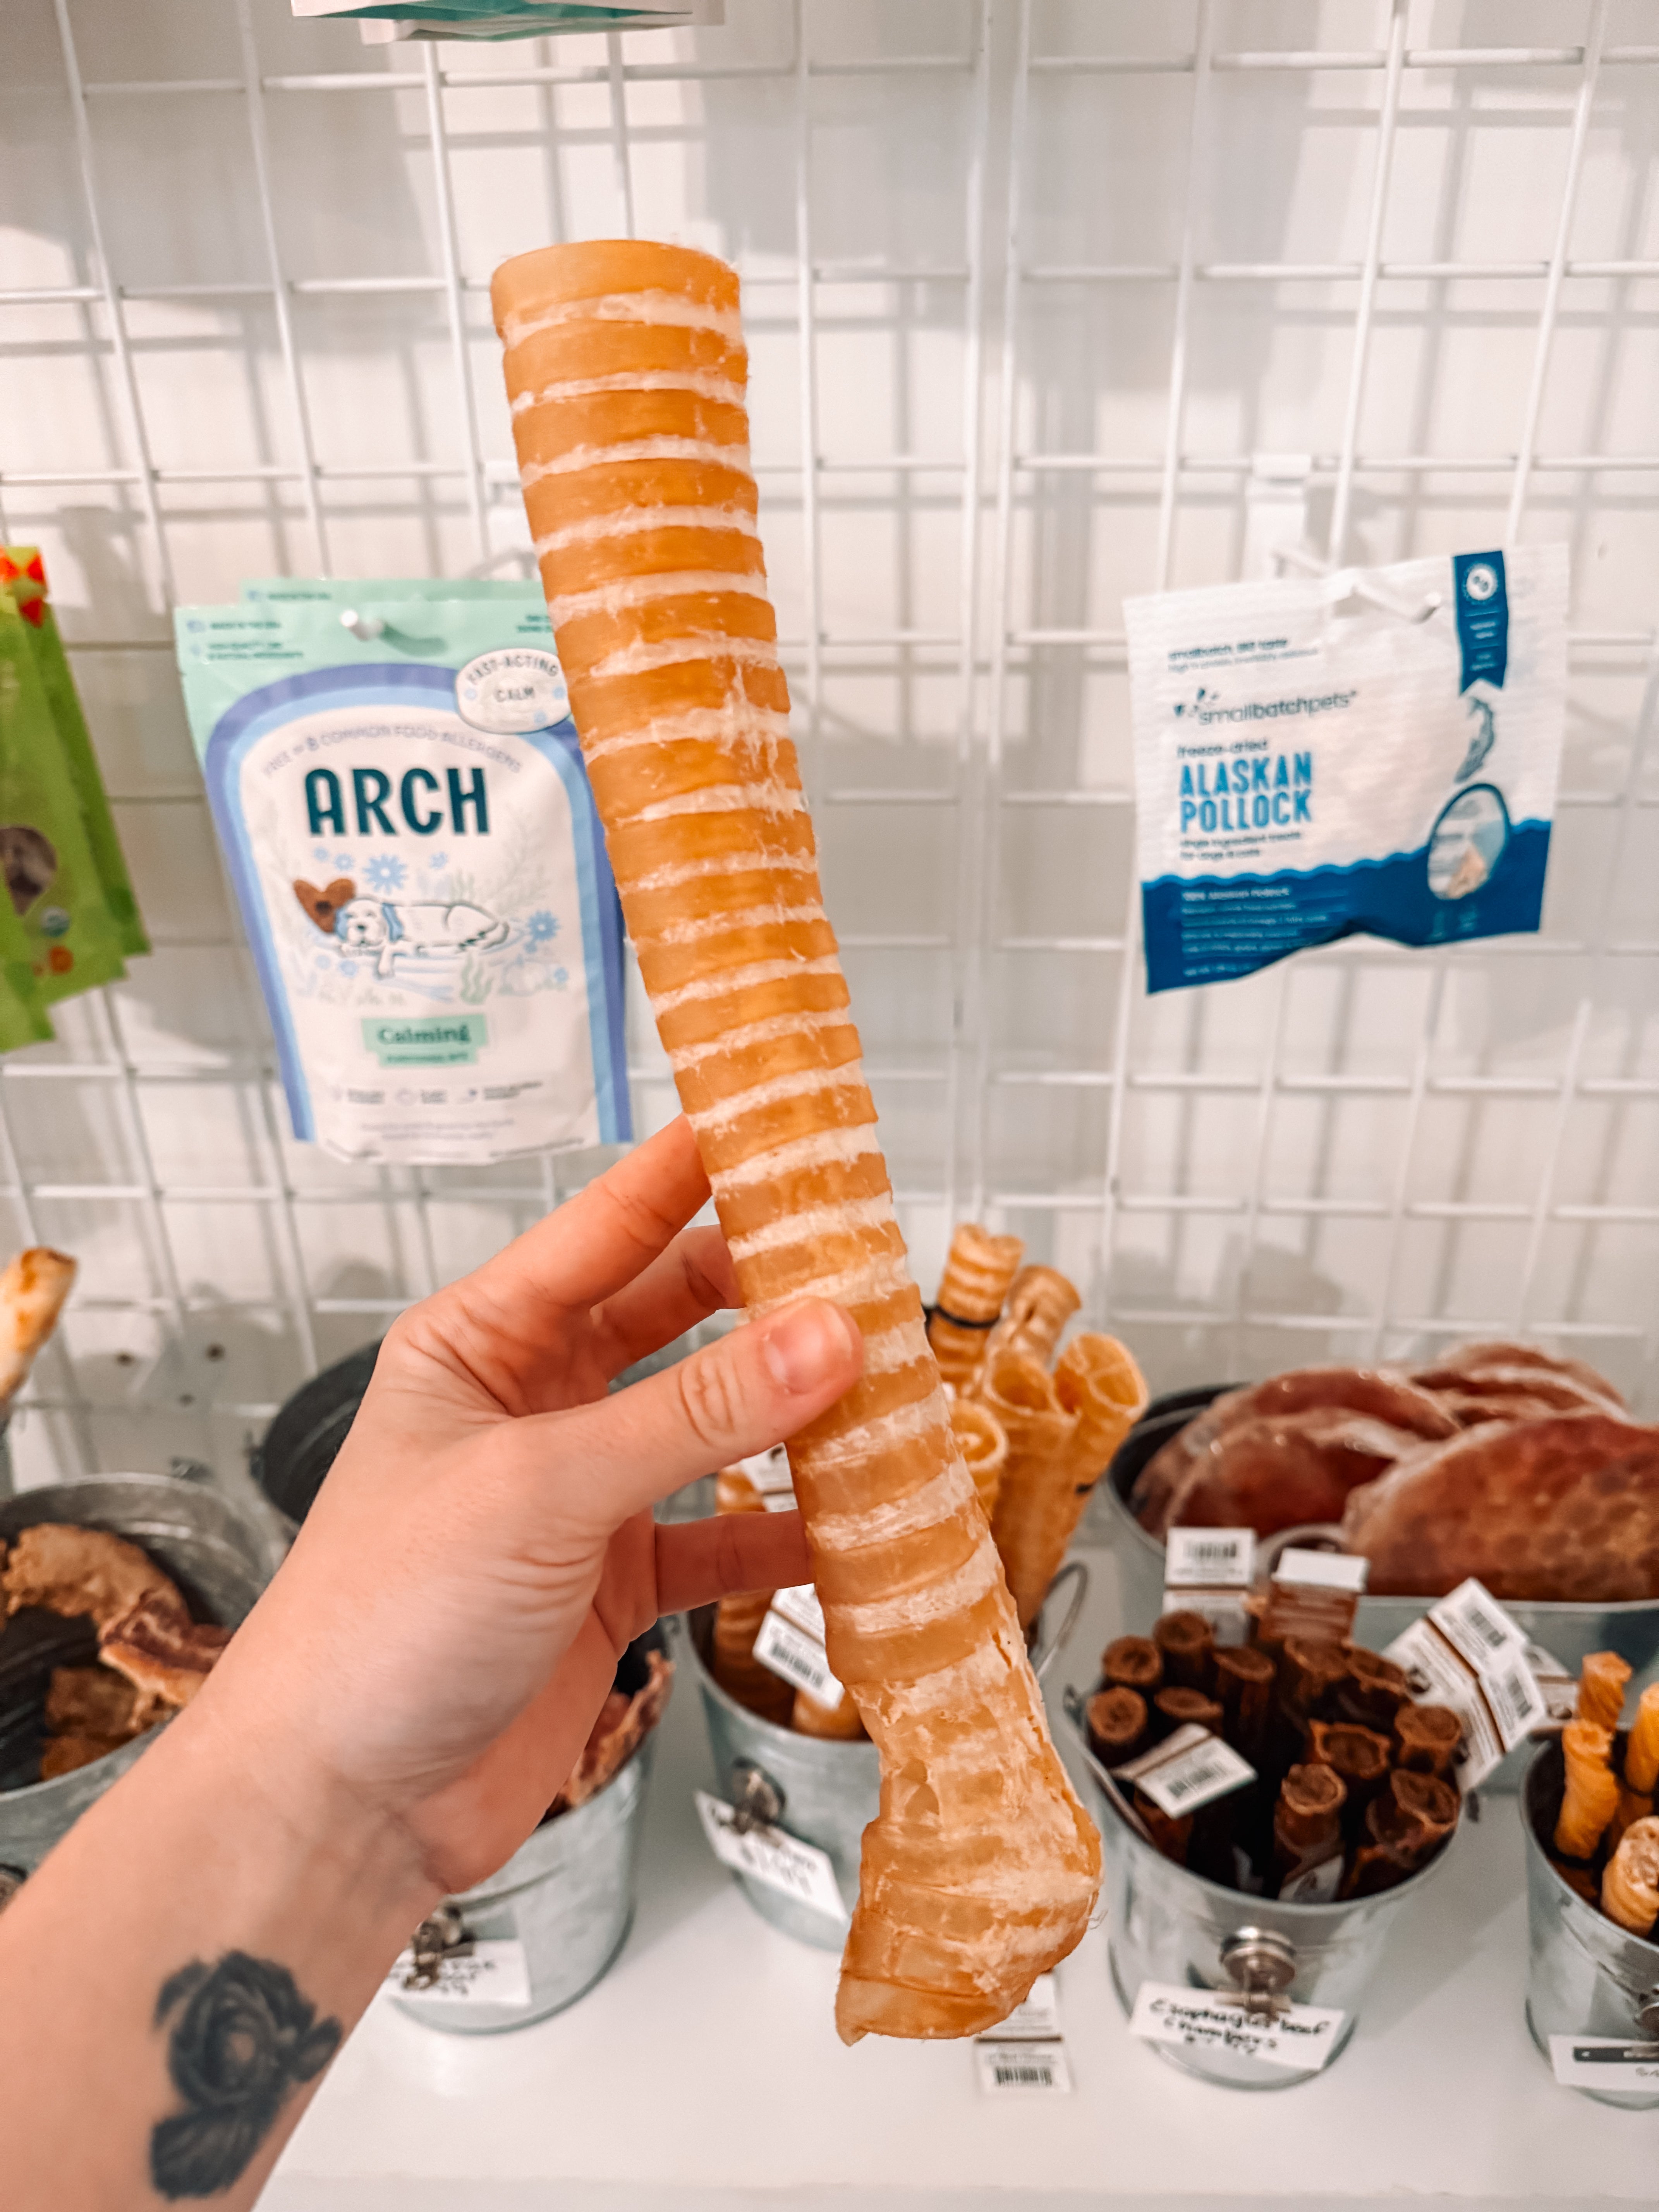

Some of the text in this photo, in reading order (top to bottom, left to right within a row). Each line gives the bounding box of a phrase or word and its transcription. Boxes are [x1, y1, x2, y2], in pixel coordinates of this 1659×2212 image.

[467, 654, 559, 685] FAST-ACTING
[495, 687, 535, 702] CALM
[320, 725, 391, 747] COMMON
[394, 725, 438, 740] FOOD
[442, 733, 520, 773] ALLERGENS
[1176, 737, 1268, 758] freeze-dried
[1179, 751, 1312, 797] ALASKAN
[305, 768, 489, 835] ARCH
[1180, 788, 1312, 834] POLLOCK
[378, 1024, 470, 1045] Calming
